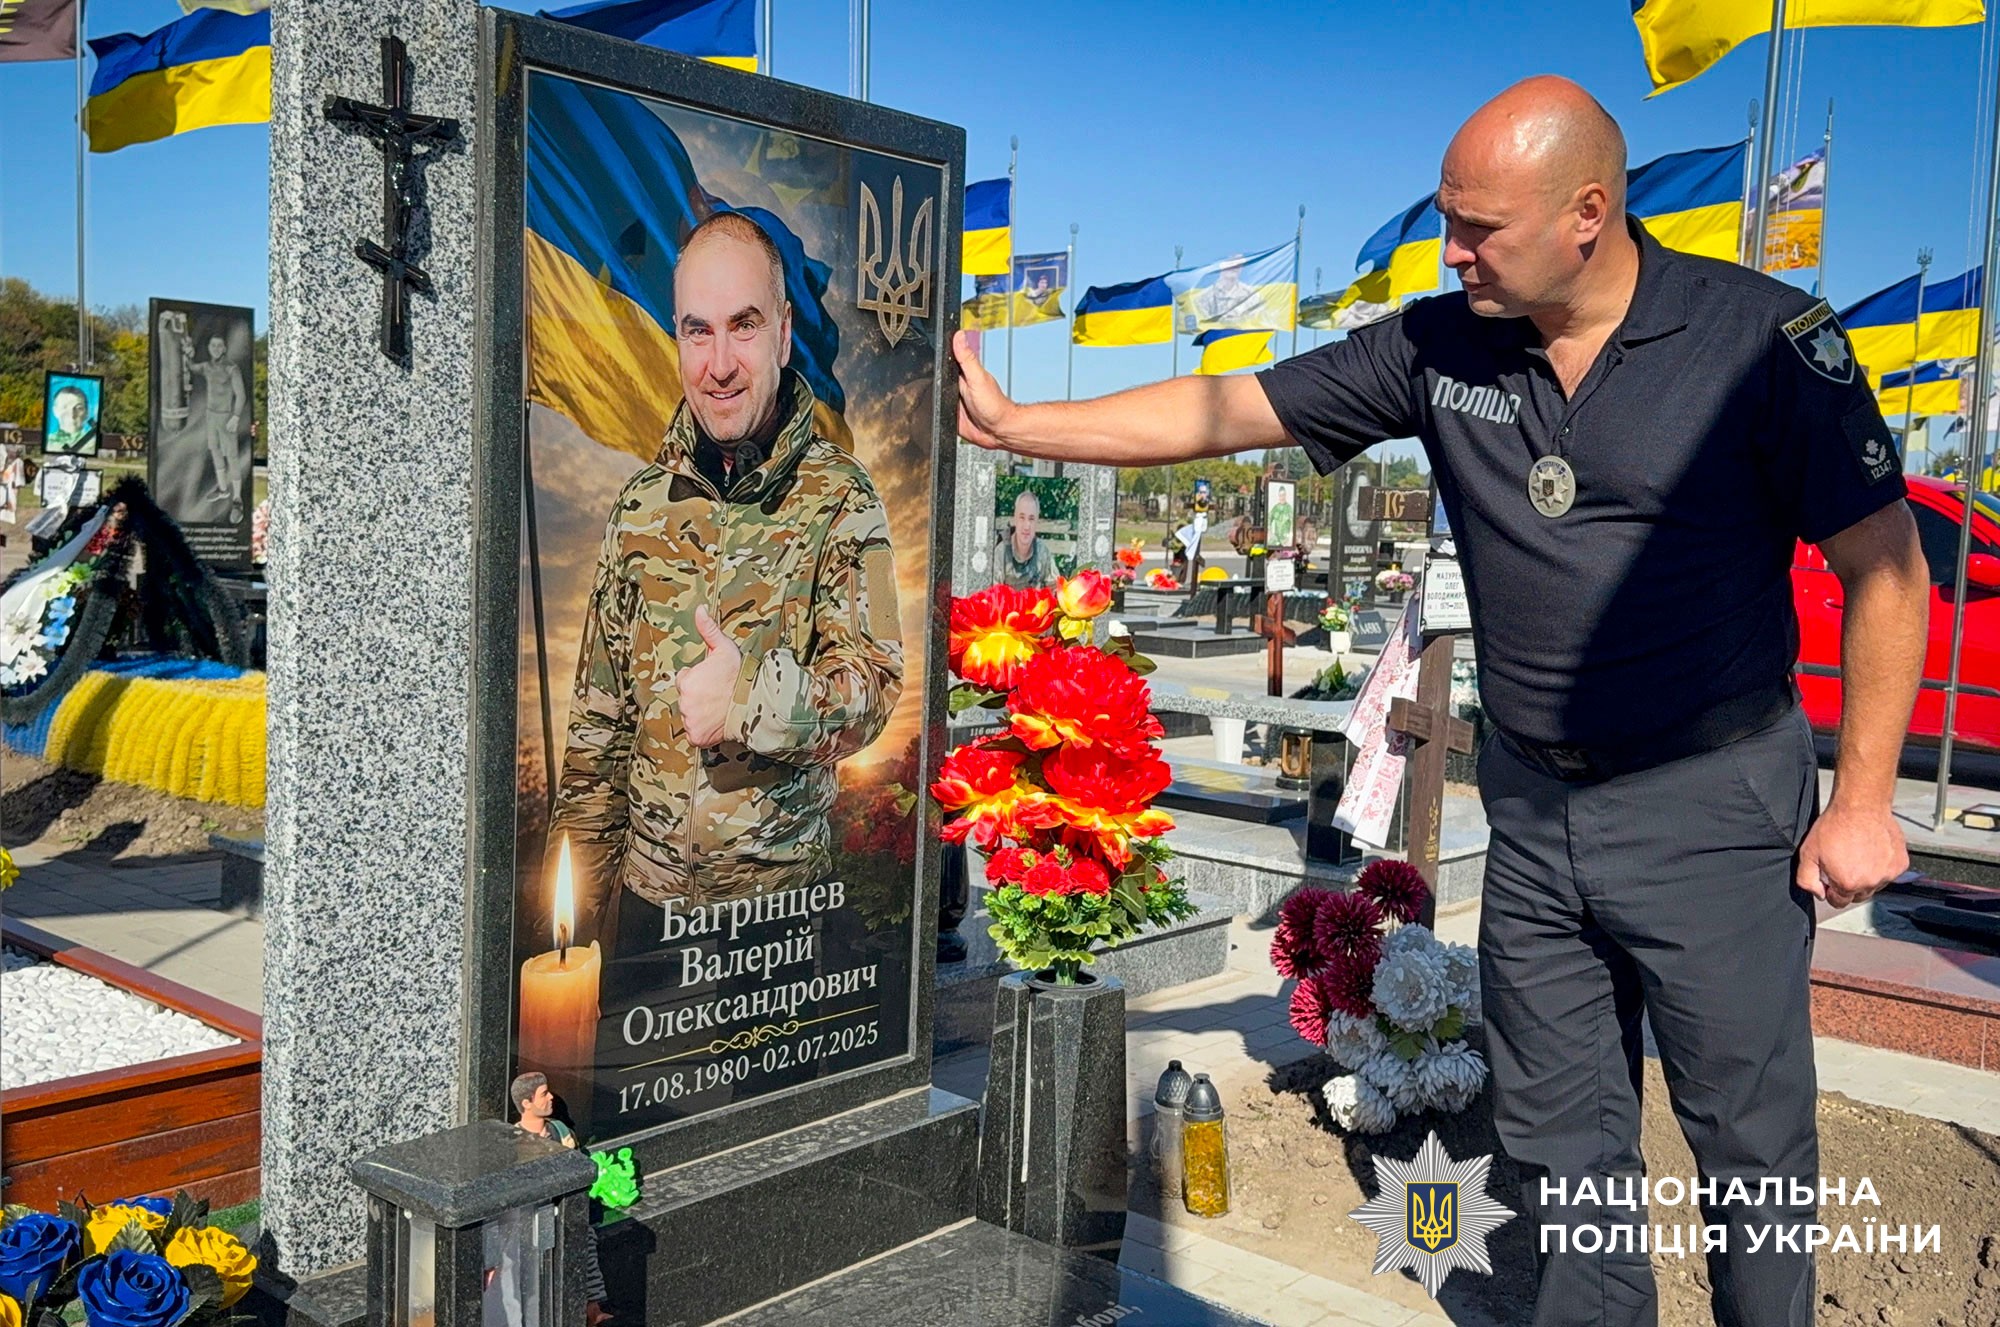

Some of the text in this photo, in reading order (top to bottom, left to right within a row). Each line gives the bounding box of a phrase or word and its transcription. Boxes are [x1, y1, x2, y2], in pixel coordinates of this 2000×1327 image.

[1431, 376, 1521, 424] ПОЛІЦІЯ
[1445, 582, 1459, 590] ОЛЕГ
[970, 727, 984, 737] 116
[660, 880, 845, 942] Багрінцев
[678, 925, 815, 989] Валерій
[622, 964, 878, 1047] Олександрович
[618, 1020, 879, 1114] 17.08.1980-02.07.2025
